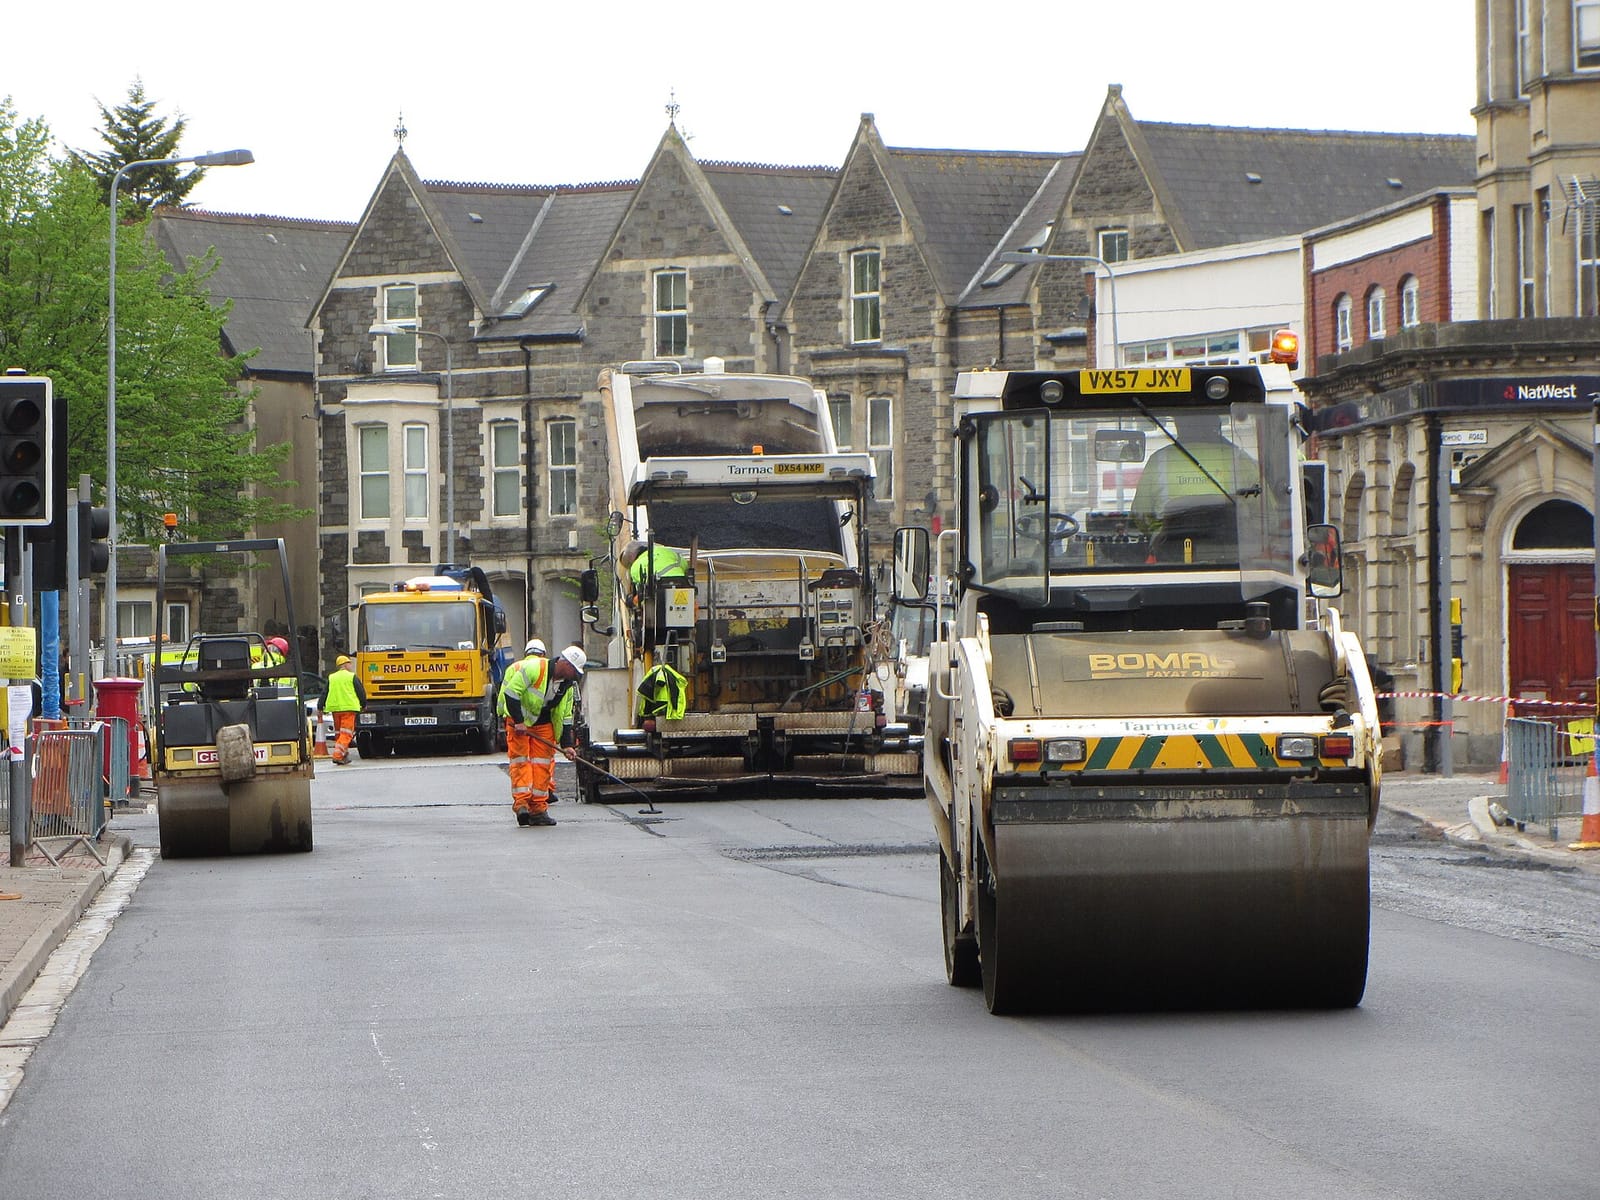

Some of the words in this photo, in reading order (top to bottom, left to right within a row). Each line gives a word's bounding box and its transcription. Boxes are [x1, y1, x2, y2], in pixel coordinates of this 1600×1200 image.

[1089, 371, 1139, 389] VX57
[1146, 370, 1182, 387] JXY
[1518, 385, 1576, 399] NatWest
[727, 464, 773, 475] Tarmac
[778, 464, 801, 472] DX54
[383, 664, 411, 674] READ
[415, 663, 449, 673] PLANT
[1145, 670, 1187, 678] FAYAT
[1120, 720, 1199, 732] Tarmac
